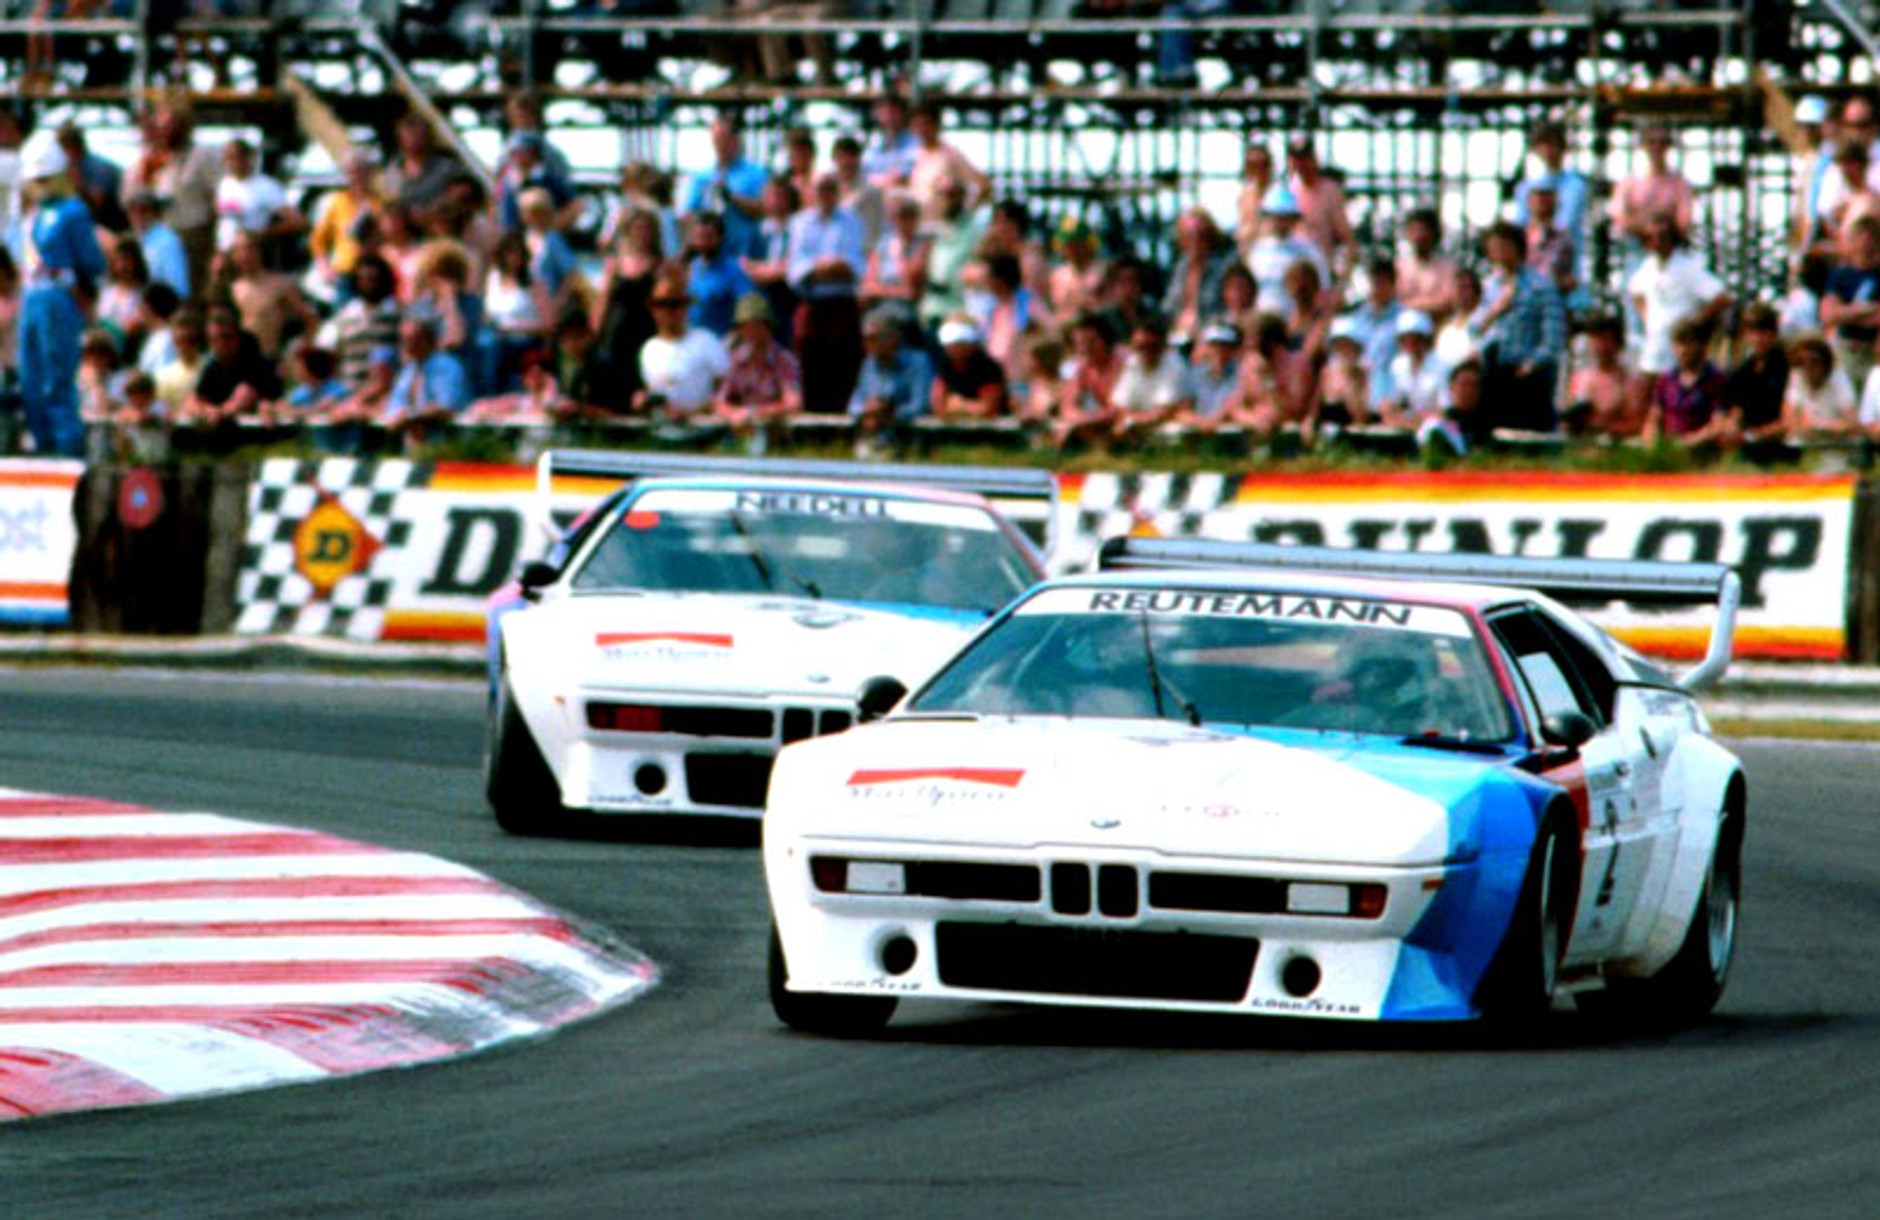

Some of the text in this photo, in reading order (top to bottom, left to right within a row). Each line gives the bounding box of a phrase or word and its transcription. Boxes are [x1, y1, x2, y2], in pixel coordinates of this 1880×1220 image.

[309, 530, 352, 563] D
[1252, 515, 1823, 612] LOP
[1089, 590, 1412, 627] REUTEMANN
